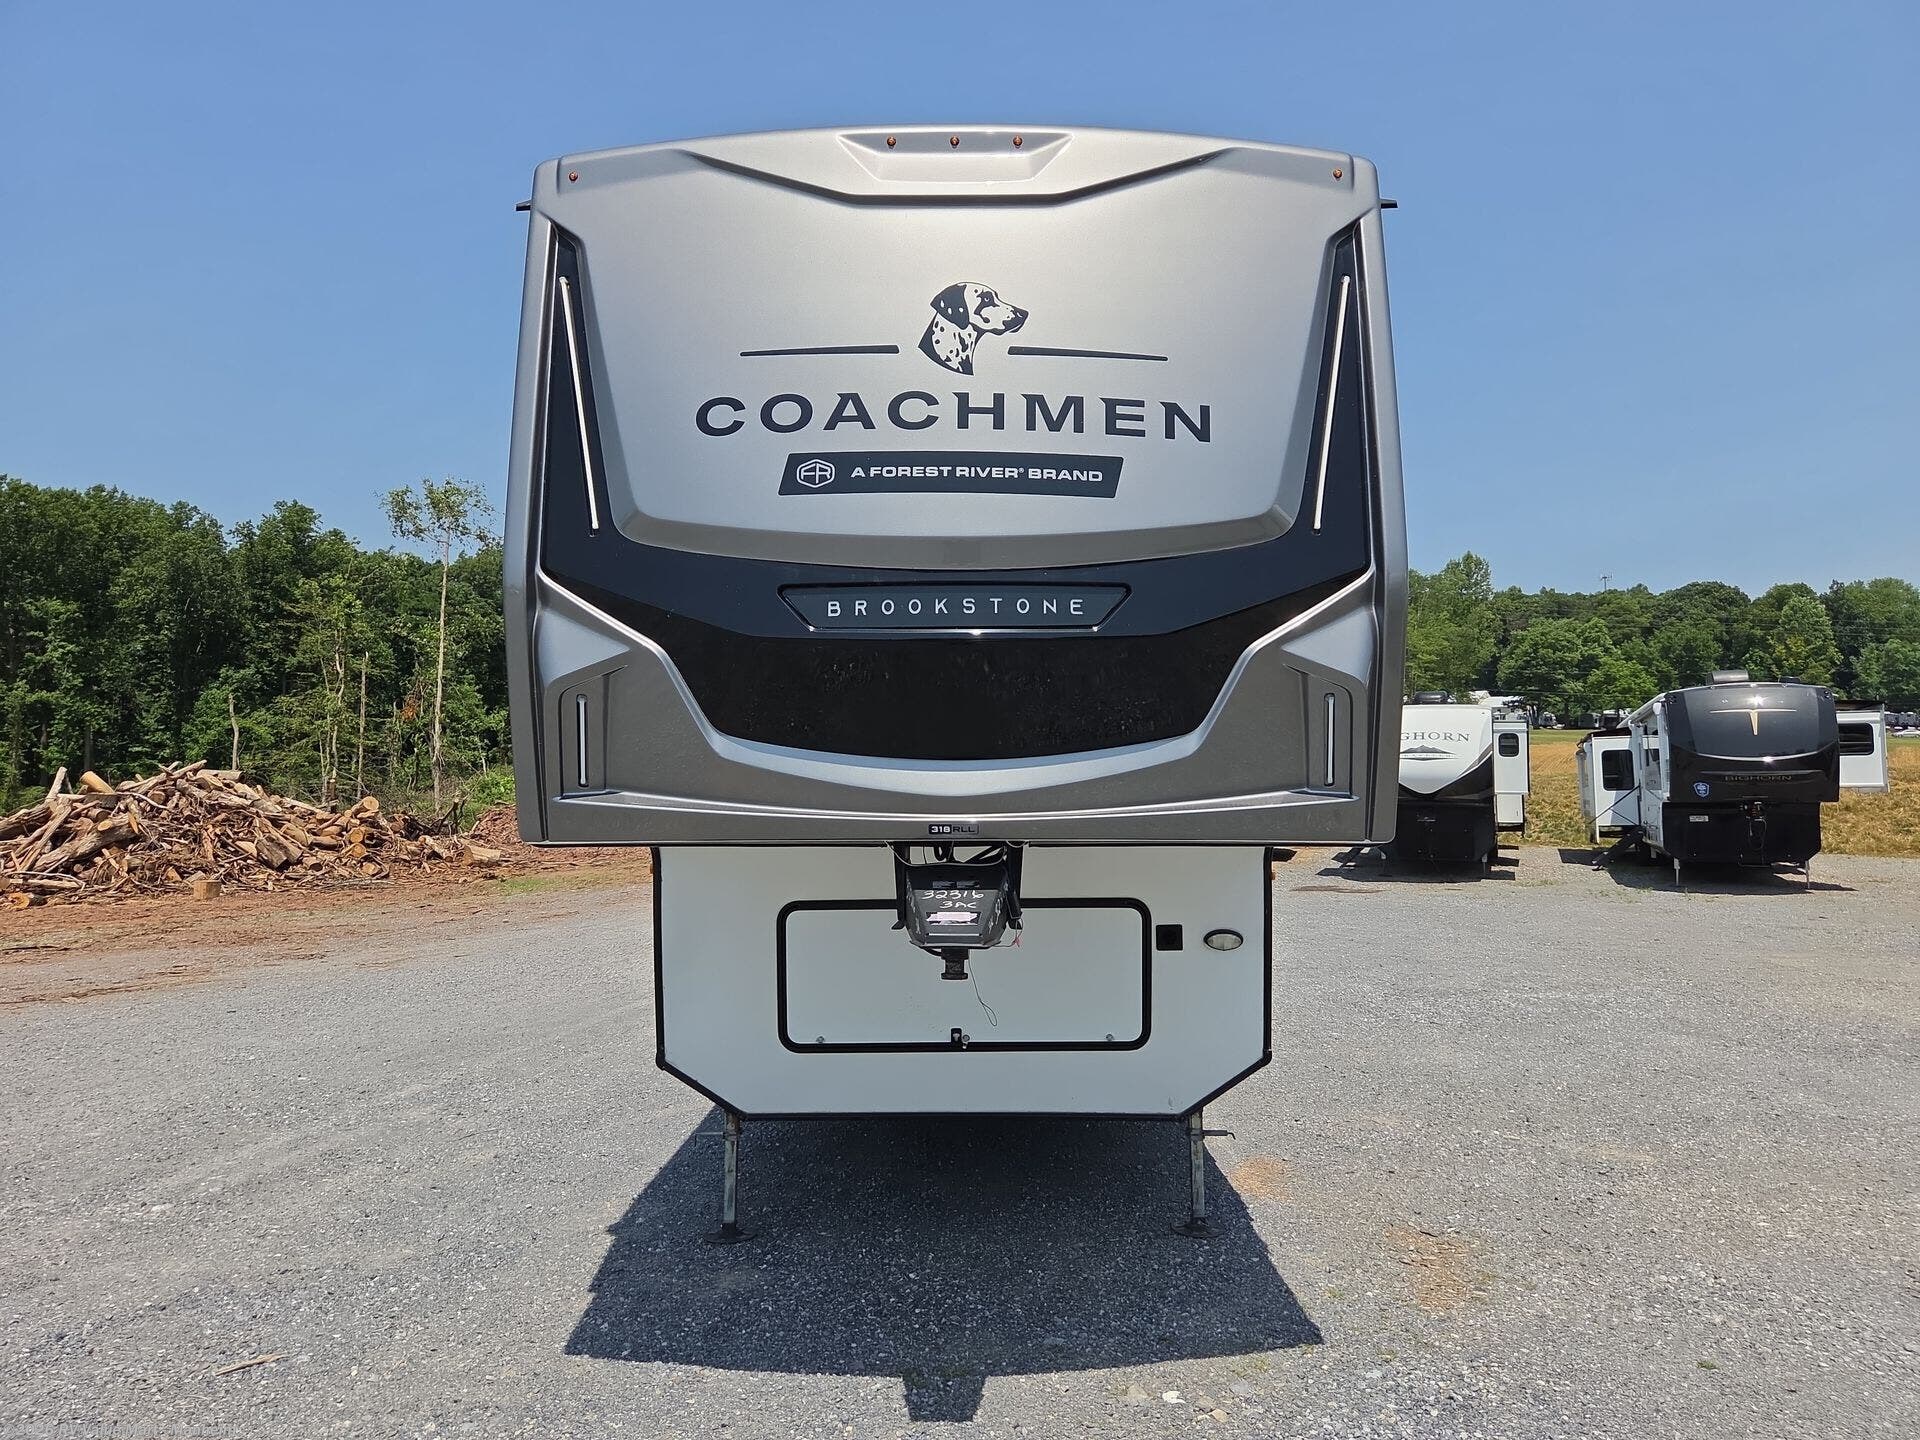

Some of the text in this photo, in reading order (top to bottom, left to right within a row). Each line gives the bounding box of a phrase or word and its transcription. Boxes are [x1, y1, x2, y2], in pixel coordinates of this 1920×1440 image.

[696, 391, 1212, 443] COACHMEN
[851, 467, 867, 479] A
[869, 467, 953, 479] FOREST
[1028, 469, 1104, 483] BRAND
[827, 597, 1084, 617] BROOKSTONE
[921, 890, 984, 899] 32316
